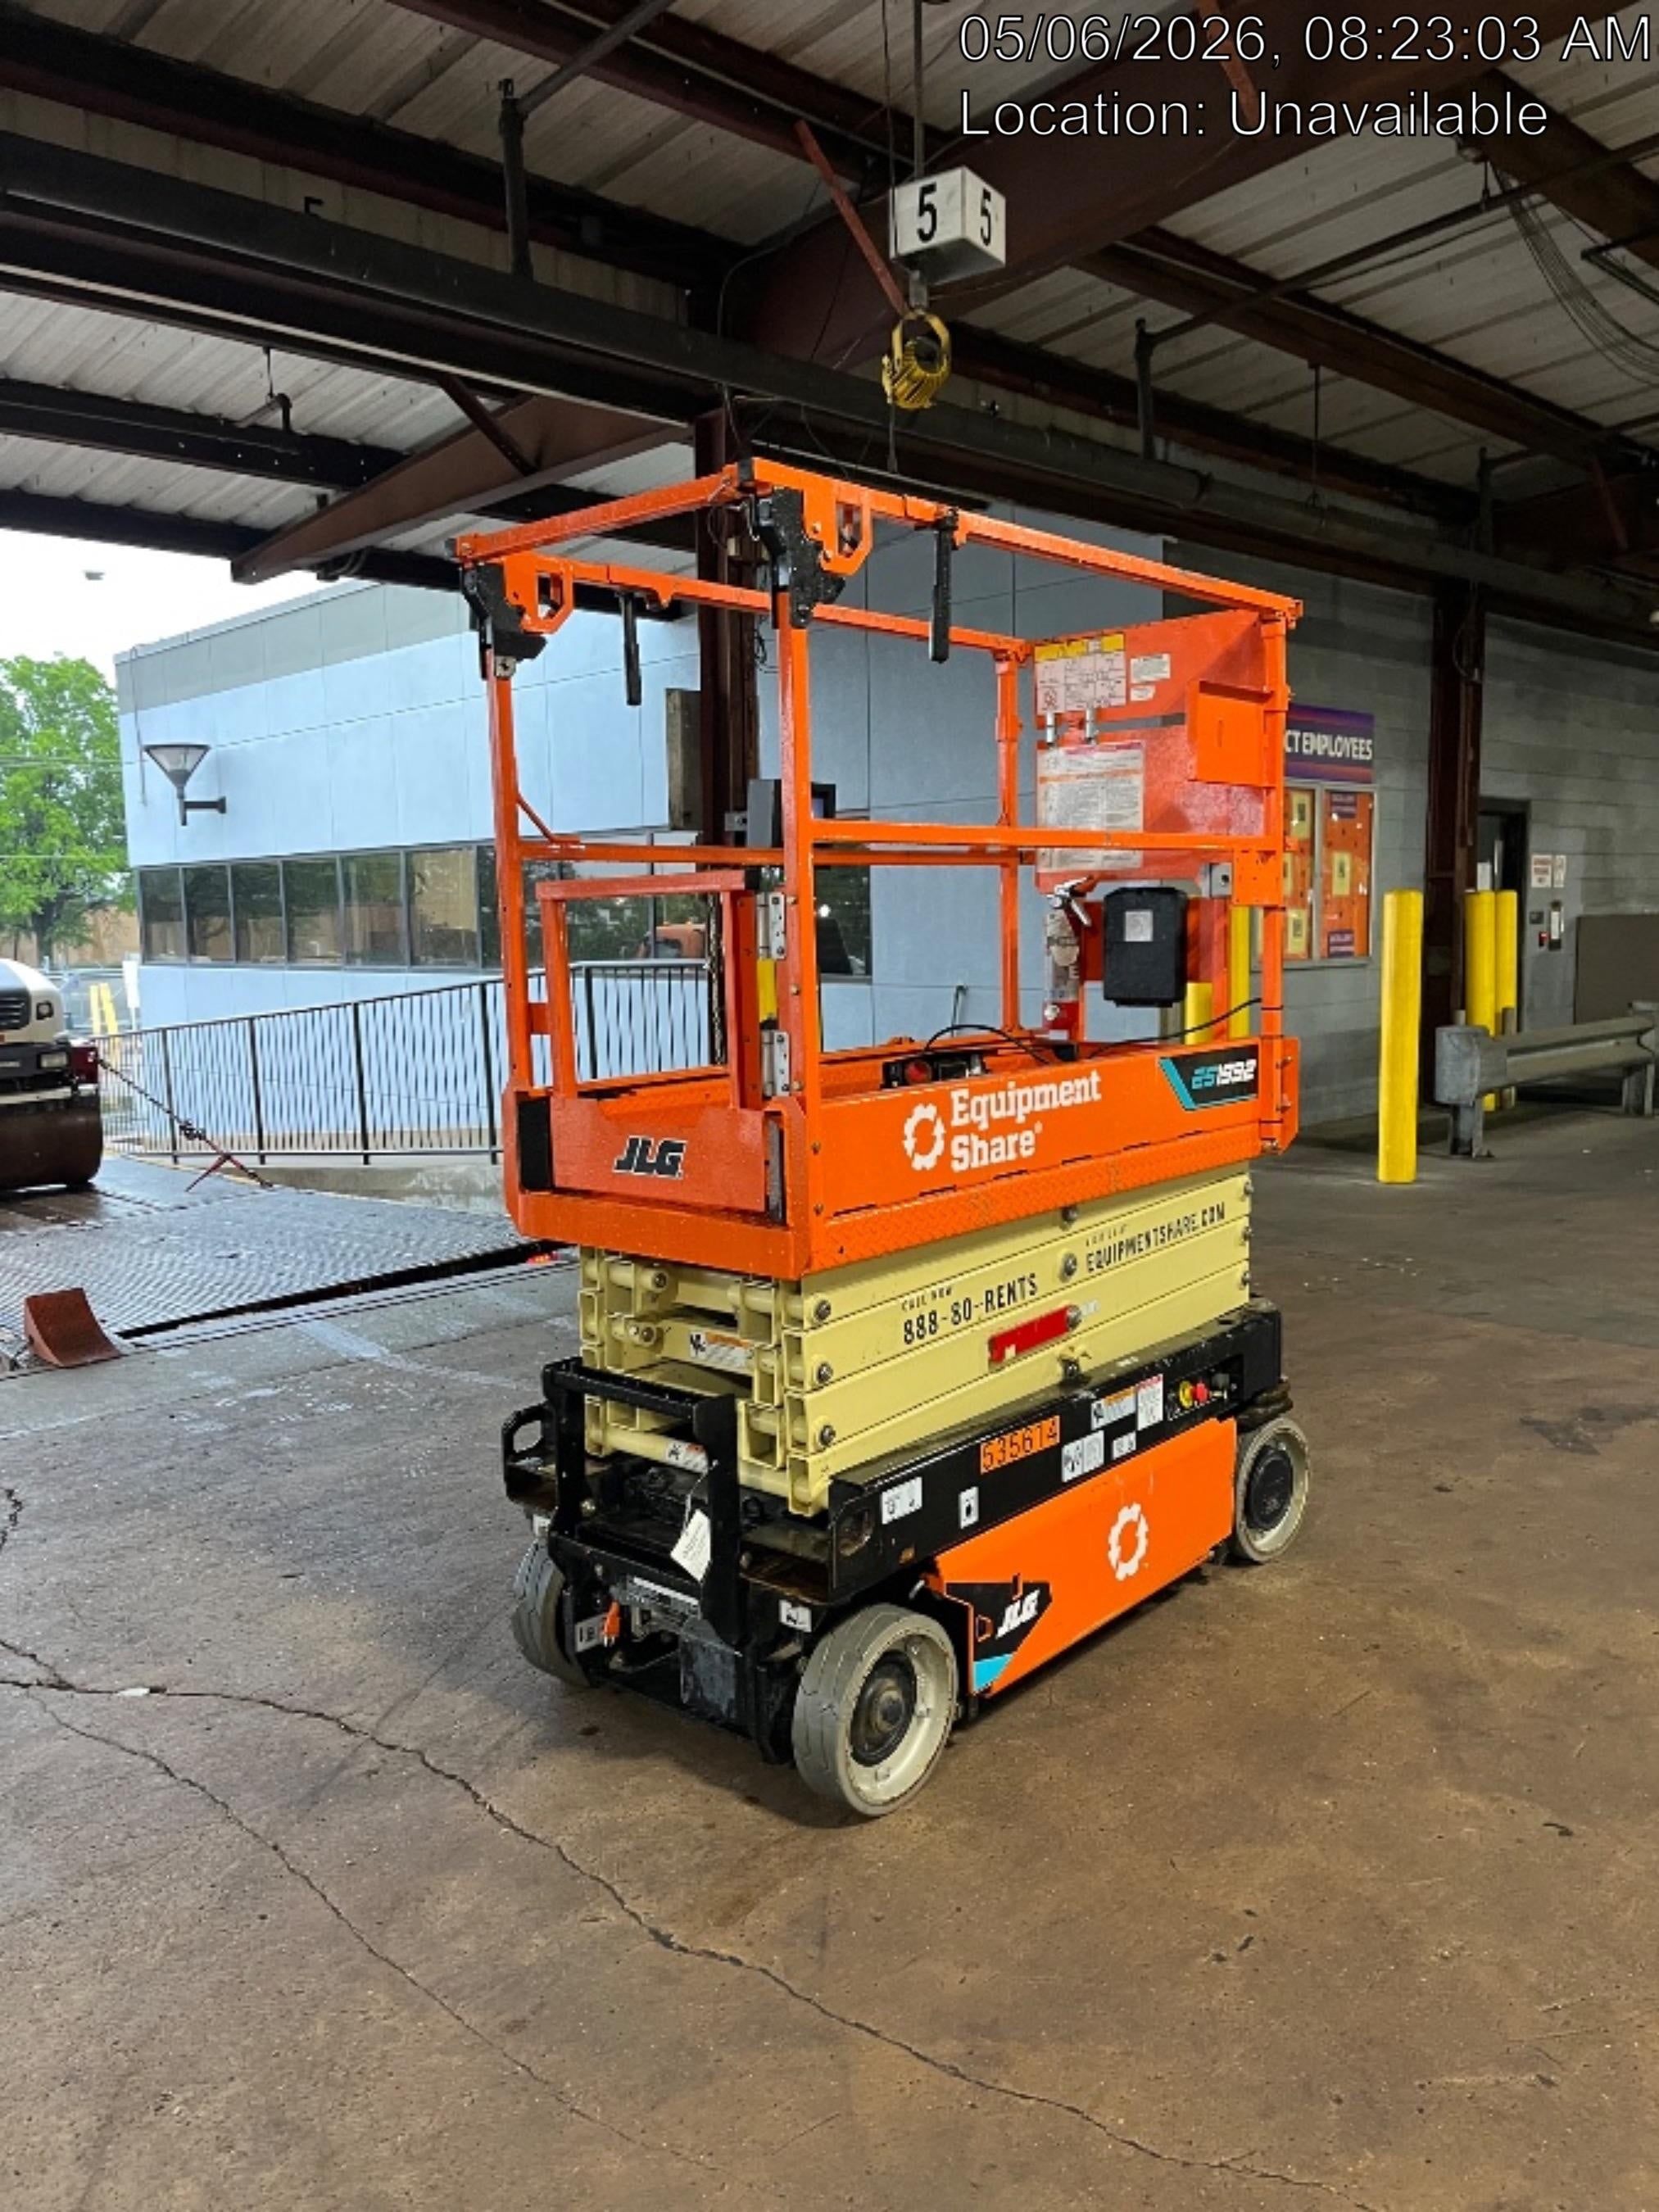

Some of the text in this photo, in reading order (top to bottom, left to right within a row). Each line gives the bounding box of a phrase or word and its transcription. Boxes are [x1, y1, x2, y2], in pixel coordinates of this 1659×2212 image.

[917, 182, 936, 243] 5
[981, 188, 991, 247] 5
[1302, 732, 1373, 760] EMPLOYEES
[950, 1069, 1102, 1131] Equipment
[613, 1135, 687, 1180] JLG
[950, 1128, 1036, 1172] Share
[1086, 1201, 1226, 1274] EQUIPMENTSHARE.COM
[995, 1589, 1040, 1639] JLG
